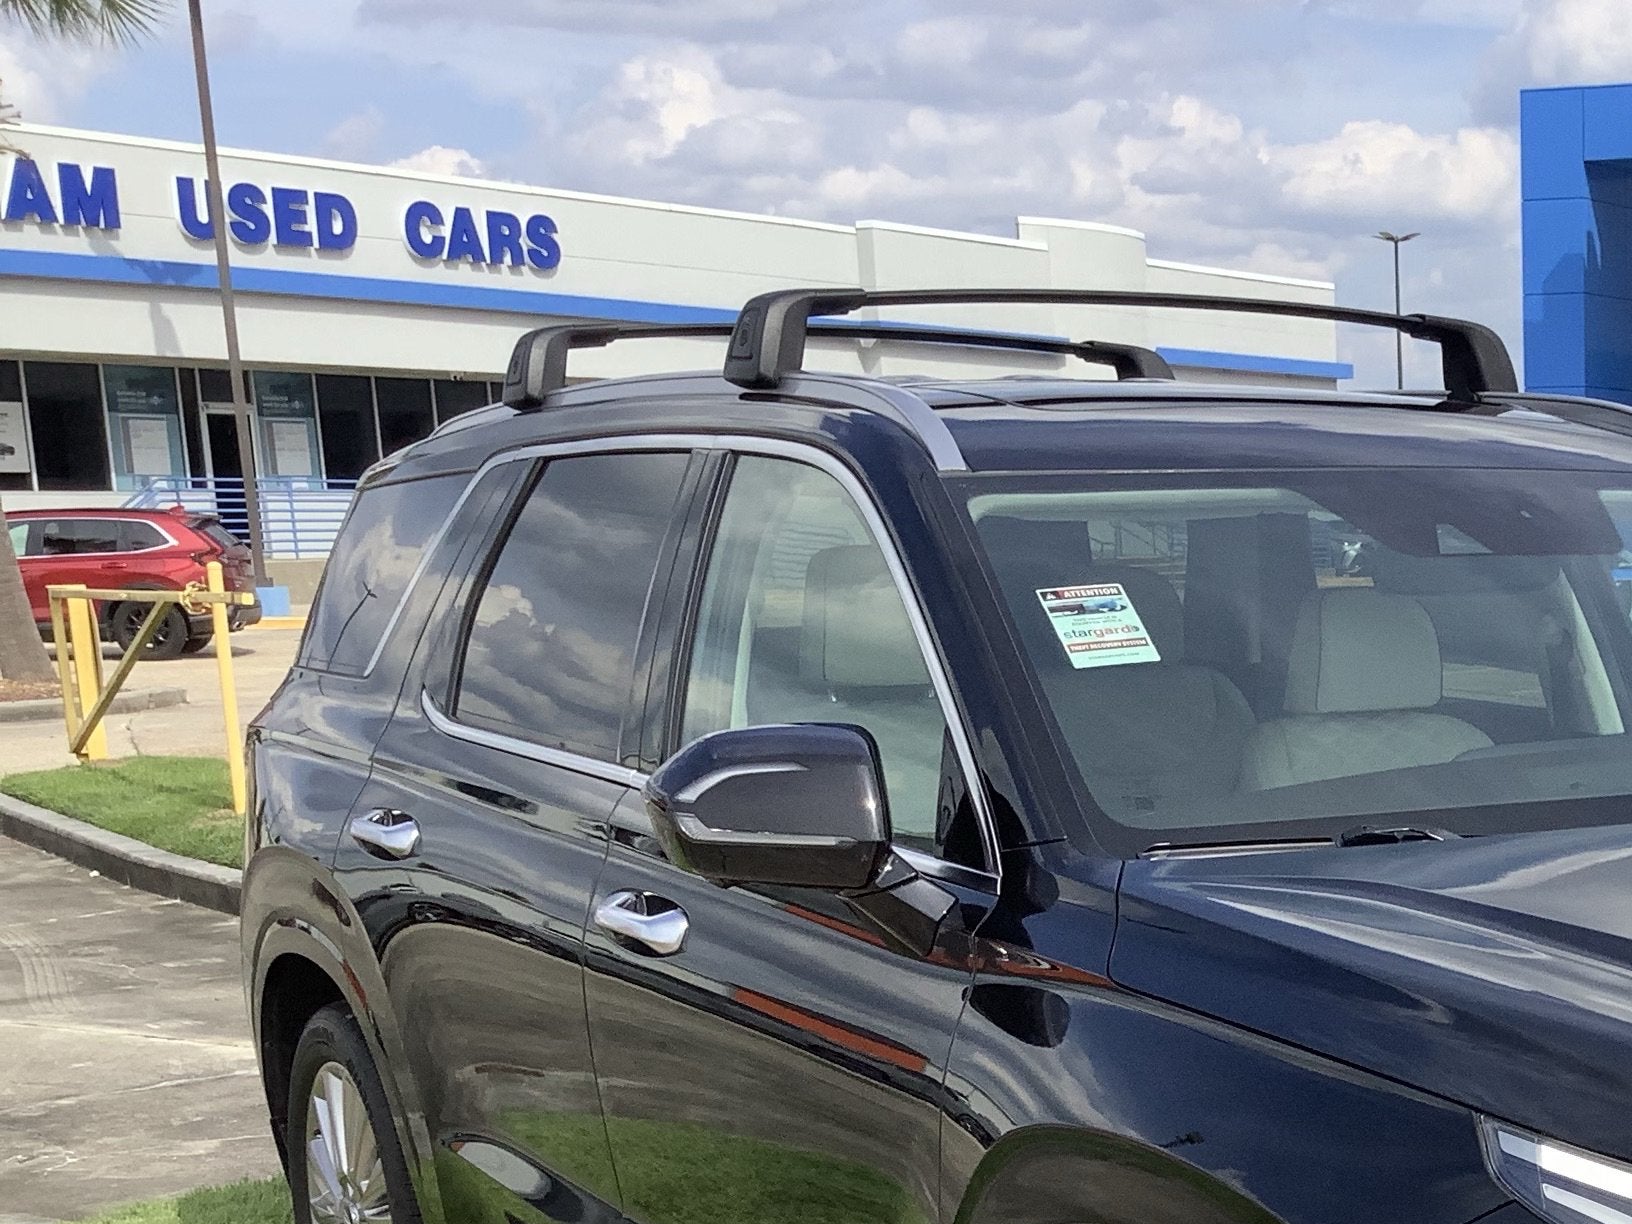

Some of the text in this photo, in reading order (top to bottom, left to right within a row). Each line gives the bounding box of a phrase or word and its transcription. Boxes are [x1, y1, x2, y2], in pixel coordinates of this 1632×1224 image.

[174, 176, 358, 250] USED
[403, 199, 562, 270] CARS
[1062, 587, 1119, 599] ATTENTION
